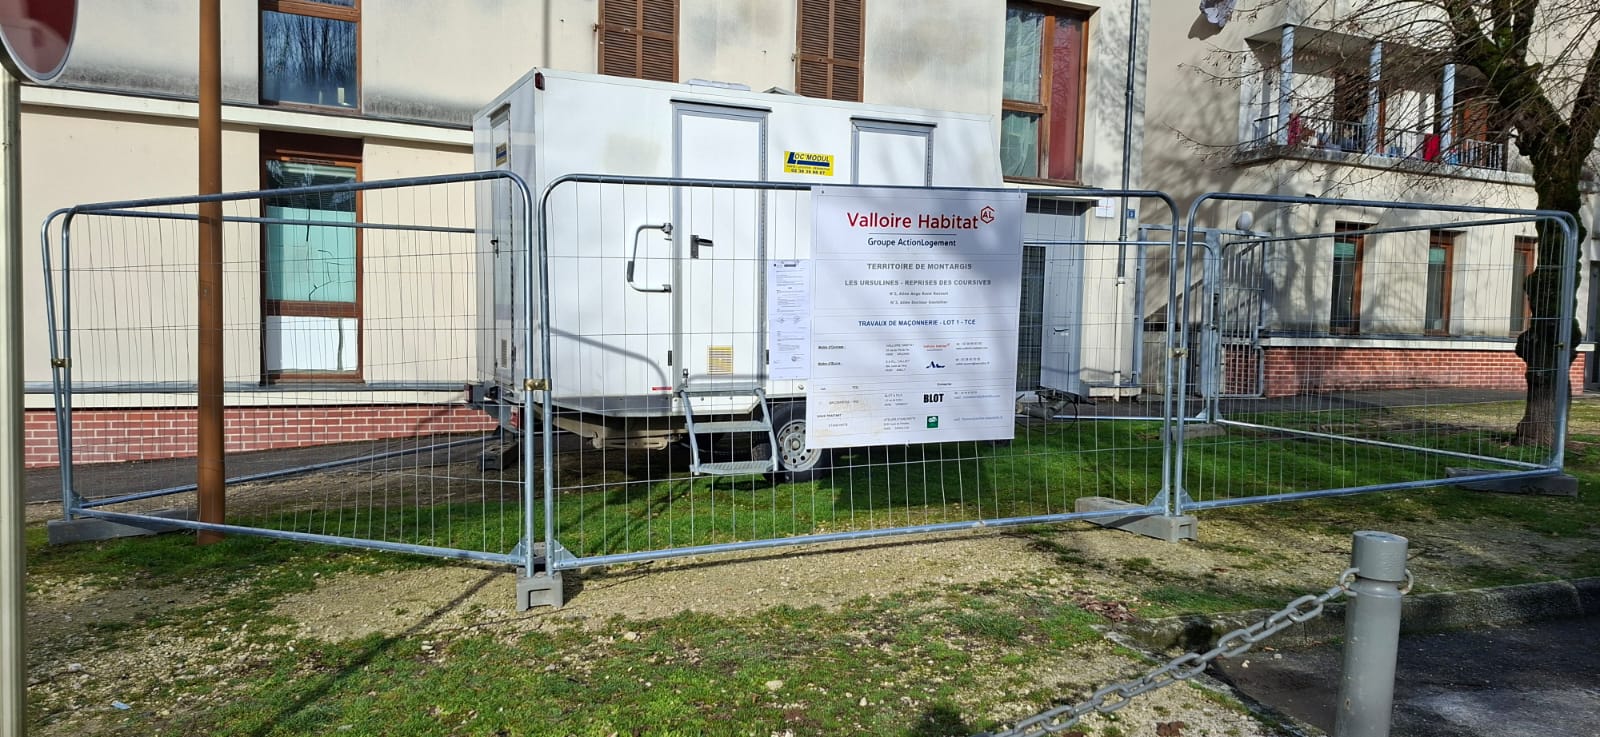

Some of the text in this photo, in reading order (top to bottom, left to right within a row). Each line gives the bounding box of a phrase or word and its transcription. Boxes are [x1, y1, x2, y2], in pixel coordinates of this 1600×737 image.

[847, 212, 979, 230] Valloire Habitat
[867, 237, 957, 248] Groupe ActionLogement
[898, 319, 938, 328] MAÇONNERIE
[923, 393, 945, 403] BLOT
